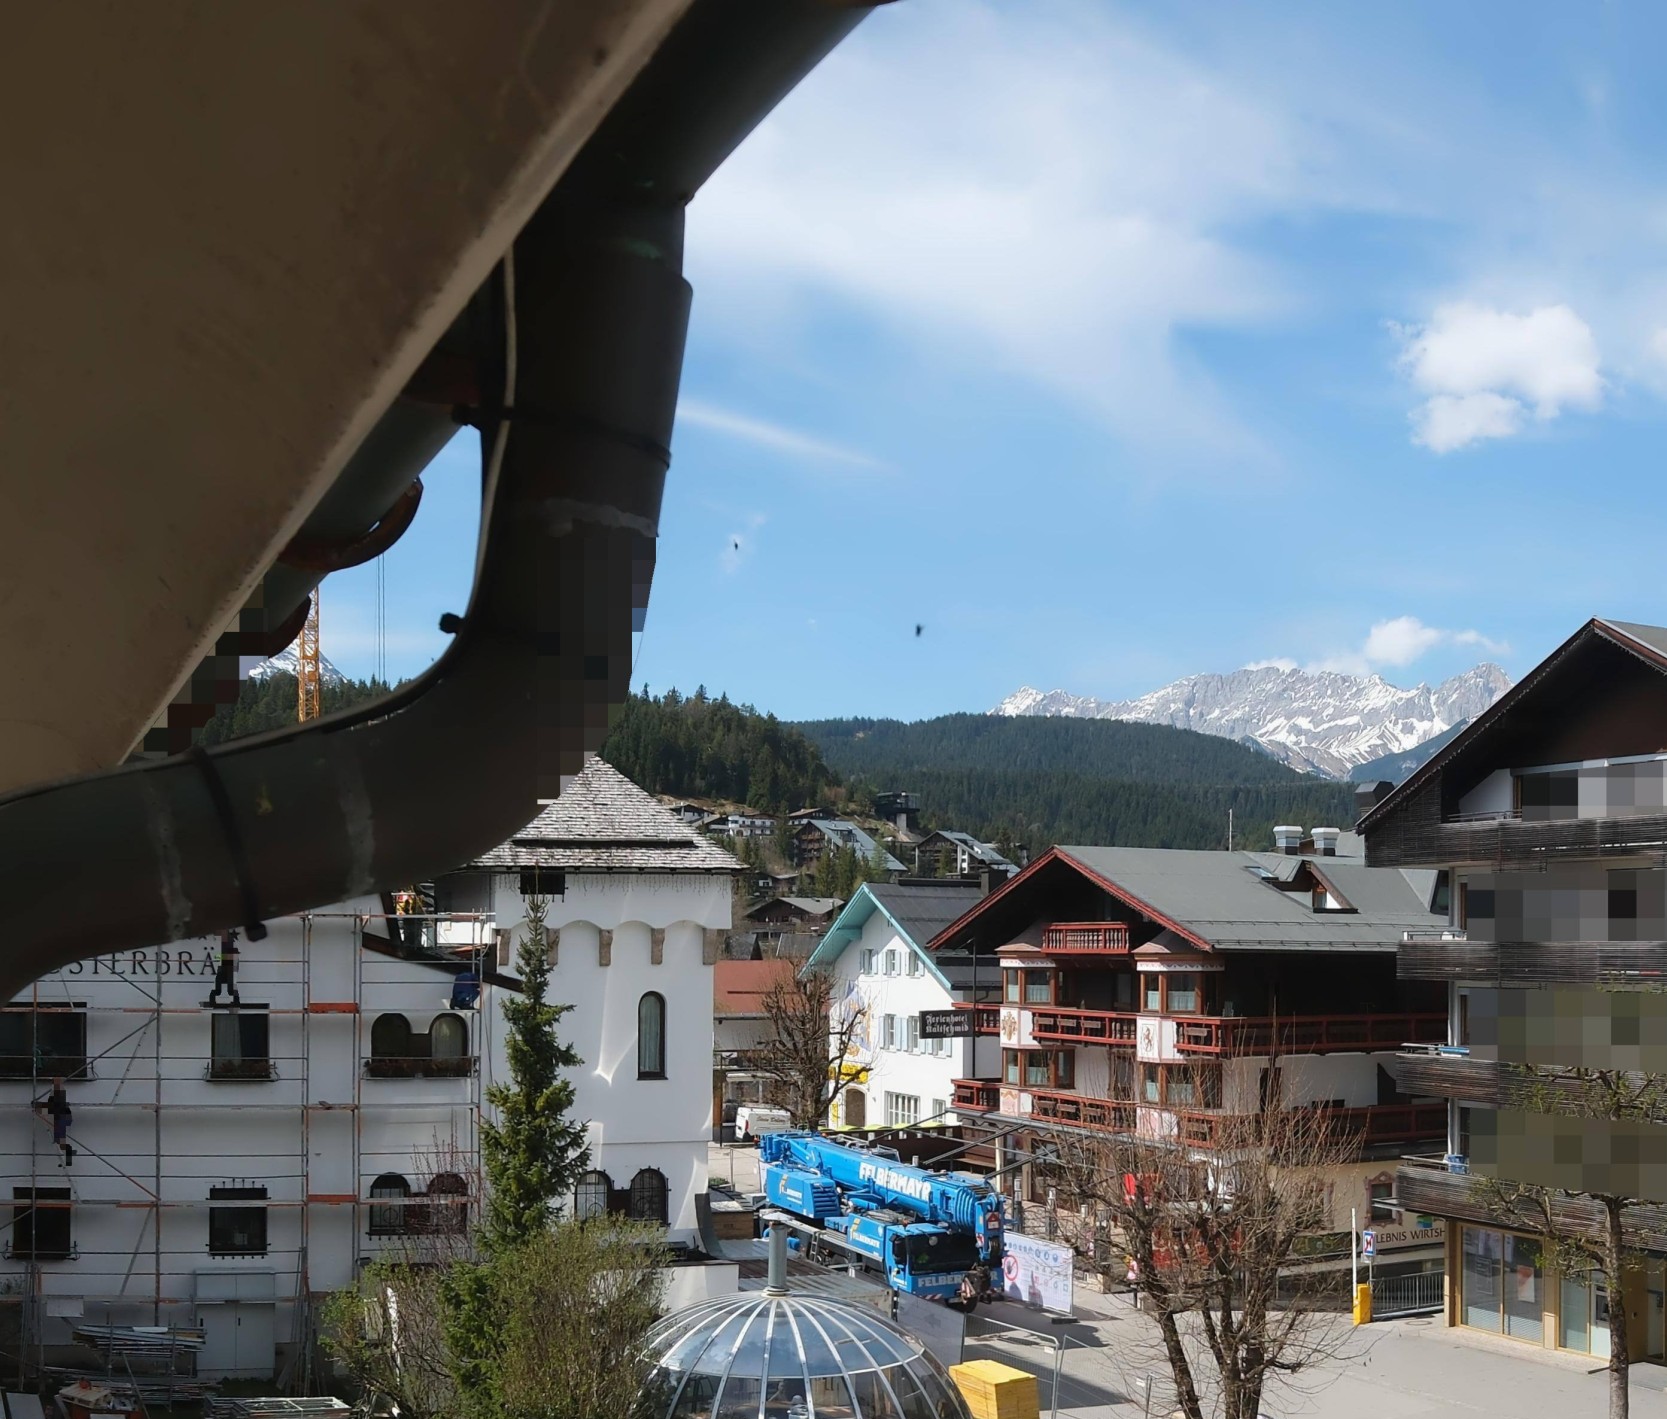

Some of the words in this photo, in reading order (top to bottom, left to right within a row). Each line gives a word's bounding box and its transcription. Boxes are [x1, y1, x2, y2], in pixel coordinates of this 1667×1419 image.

[1376, 1231, 1407, 1244] LEBNIS
[1410, 1227, 1446, 1241] WIRTSH
[917, 1270, 998, 1288] FELBERR
